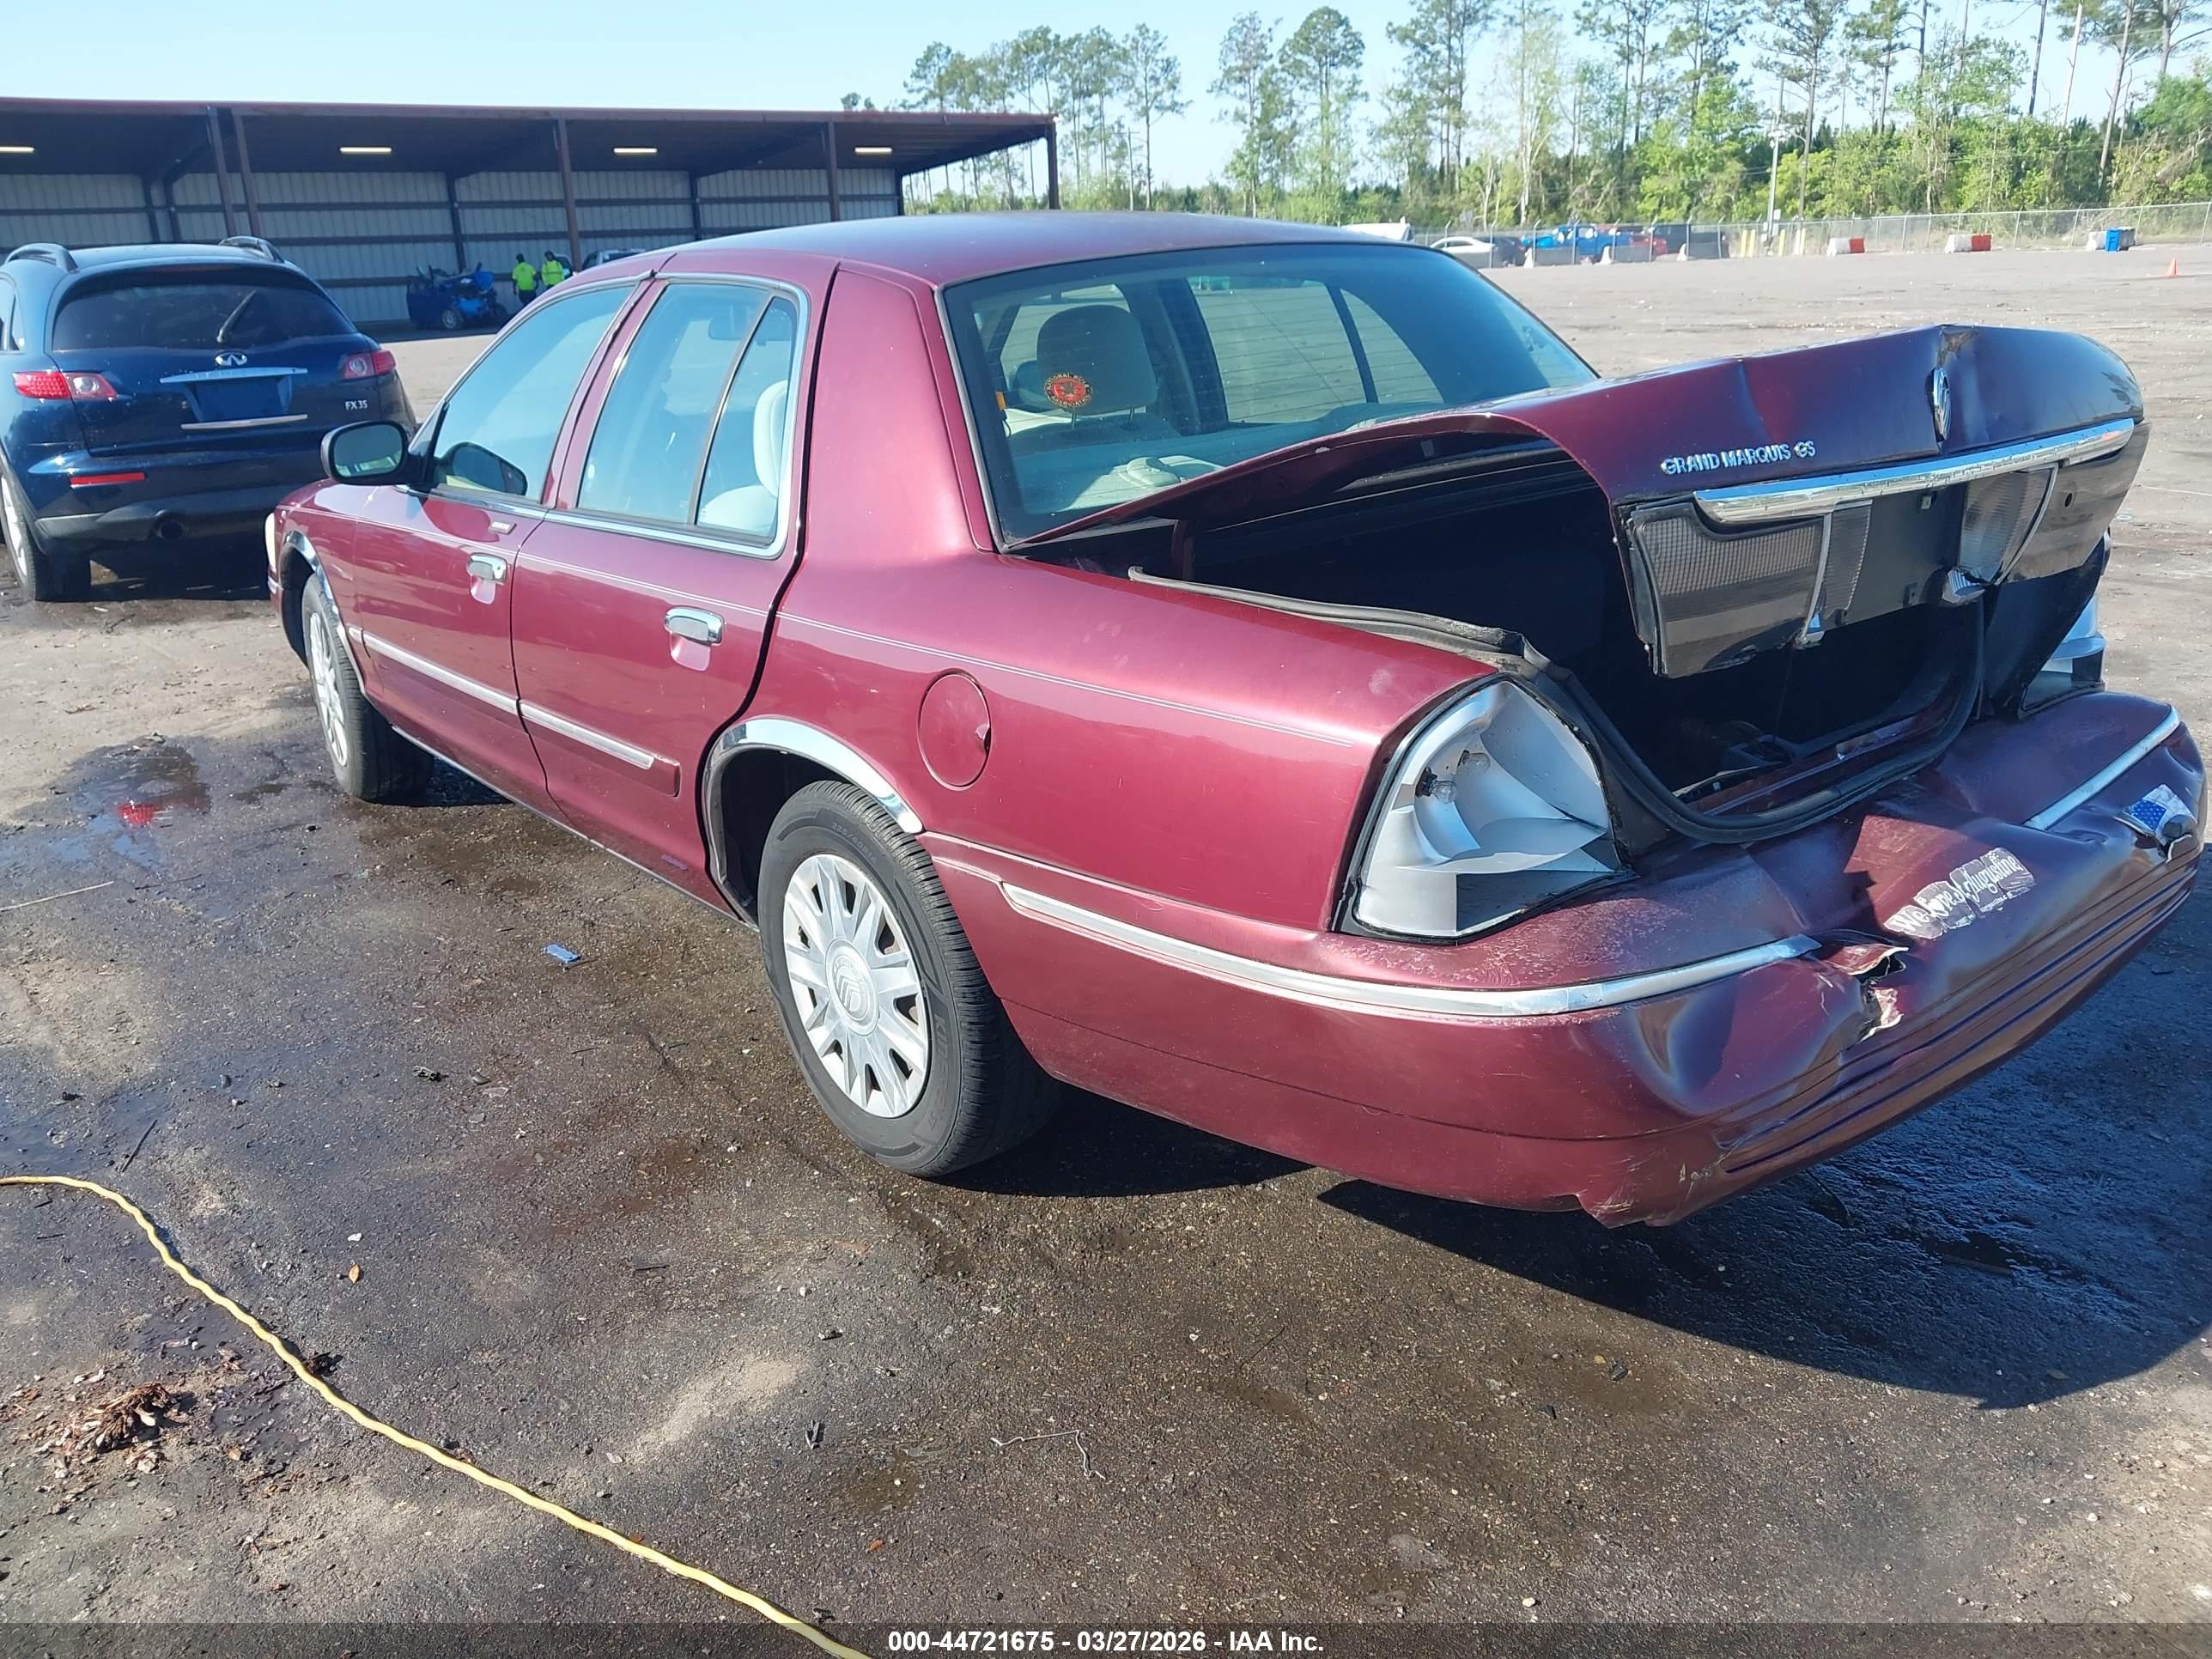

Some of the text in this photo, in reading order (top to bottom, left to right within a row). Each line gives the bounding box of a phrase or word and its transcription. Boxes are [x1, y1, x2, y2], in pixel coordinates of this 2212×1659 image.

[1661, 441, 1816, 474] GRAND MARQUIS GS
